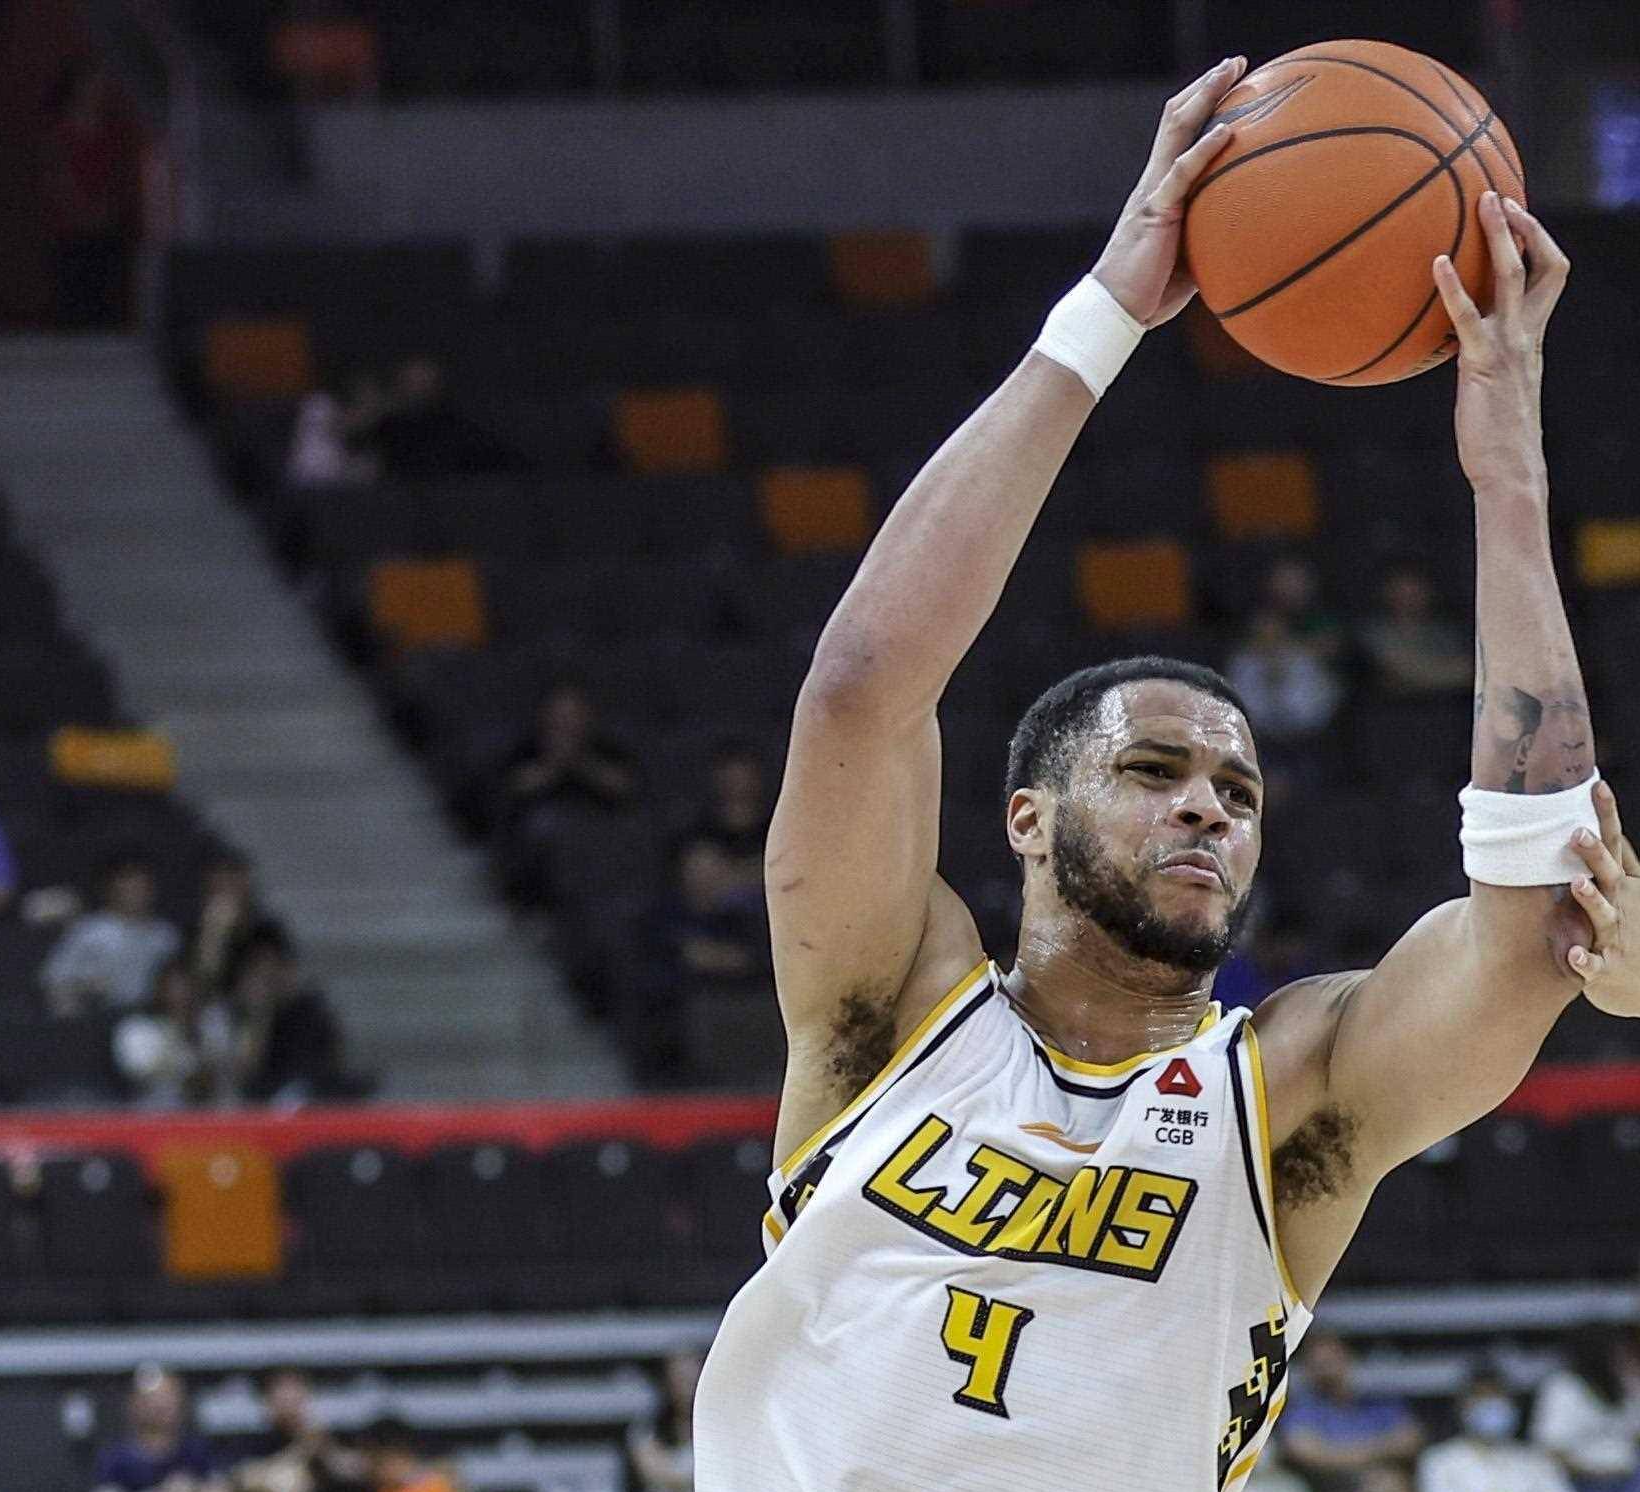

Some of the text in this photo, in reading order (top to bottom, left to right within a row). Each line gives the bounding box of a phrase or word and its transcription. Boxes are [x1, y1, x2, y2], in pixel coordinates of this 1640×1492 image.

[1144, 1106, 1209, 1128] 广发银行
[1155, 1127, 1195, 1146] CGB
[940, 1284, 1035, 1419] 4
